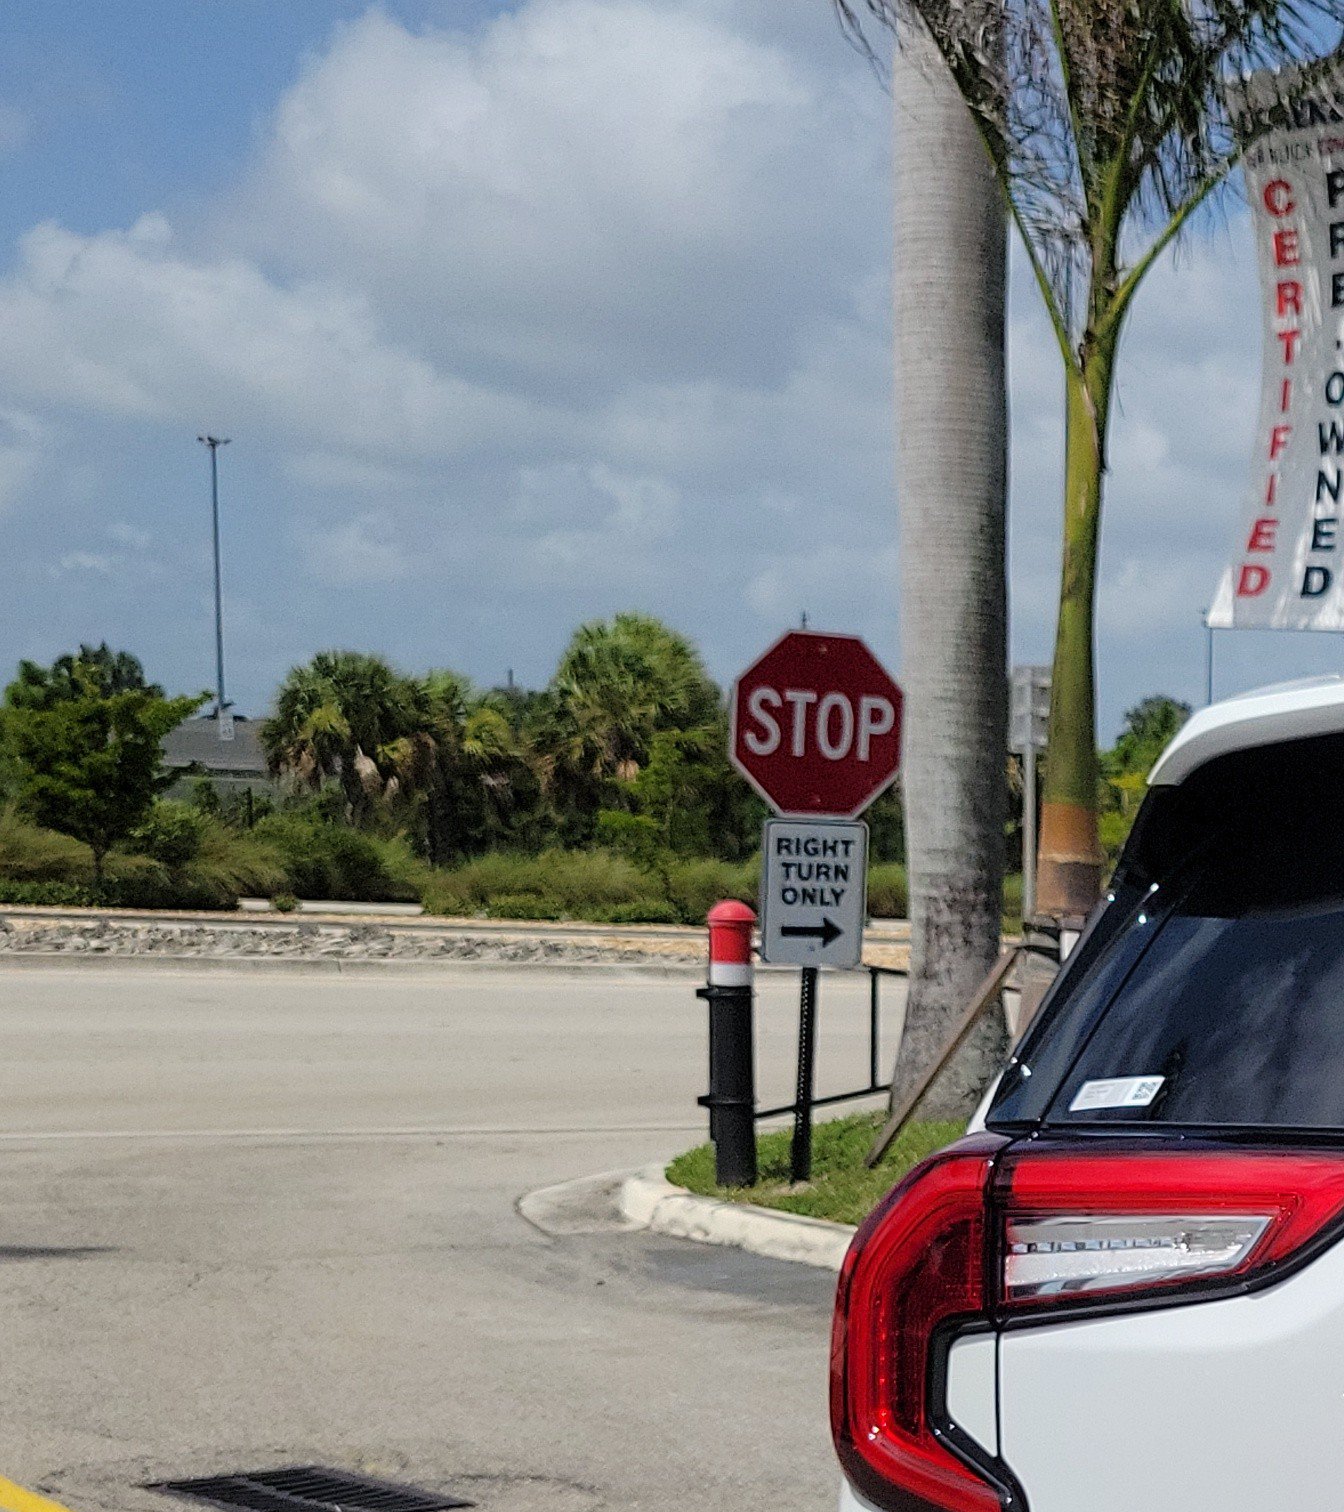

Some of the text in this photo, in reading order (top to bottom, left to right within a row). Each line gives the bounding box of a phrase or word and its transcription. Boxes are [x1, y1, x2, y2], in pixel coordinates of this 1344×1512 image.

[1237, 178, 1303, 598] CERTIFIED
[744, 685, 896, 762] STOP
[776, 837, 854, 858] RIGHT
[781, 862, 850, 882] TURN
[781, 887, 846, 907] ONLY
